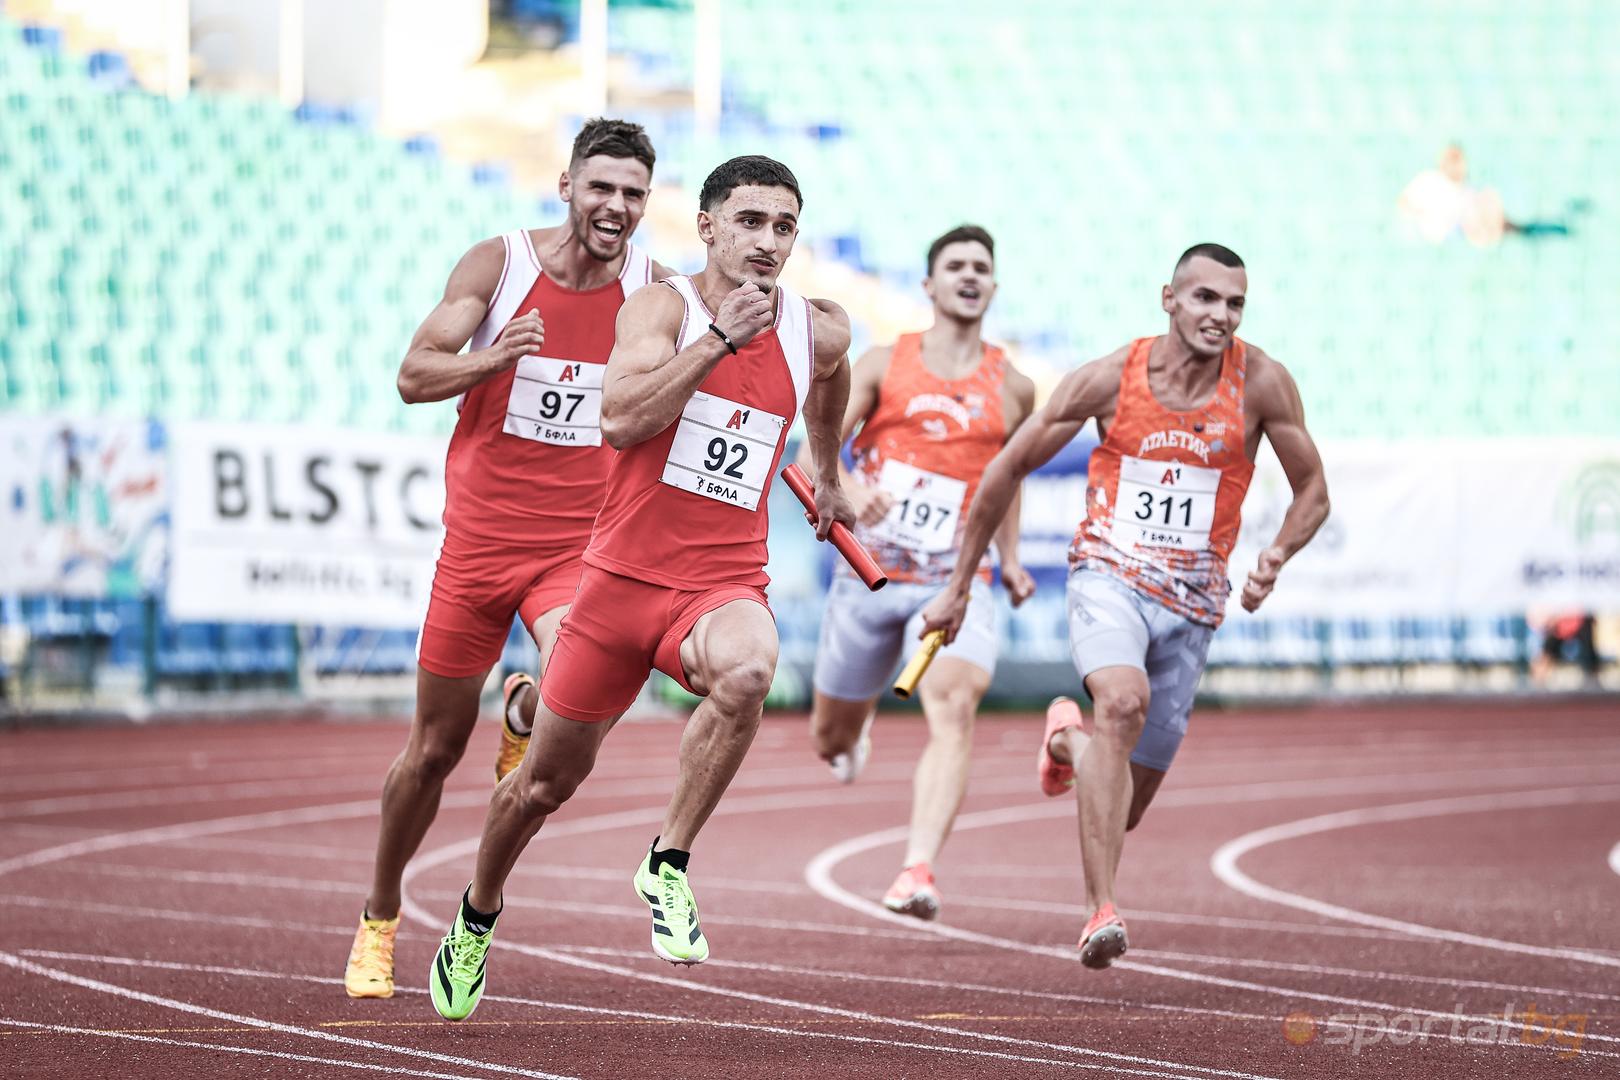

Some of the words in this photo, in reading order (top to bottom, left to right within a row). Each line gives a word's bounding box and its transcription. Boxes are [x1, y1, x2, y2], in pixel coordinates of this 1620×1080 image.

[558, 363, 581, 382] A1
[539, 390, 585, 422] 97
[726, 409, 751, 430] A1
[545, 428, 576, 441] БФЛА
[704, 436, 749, 480] 92
[706, 483, 738, 502] БФЛА
[899, 498, 952, 532] 197
[1135, 491, 1193, 527] 311
